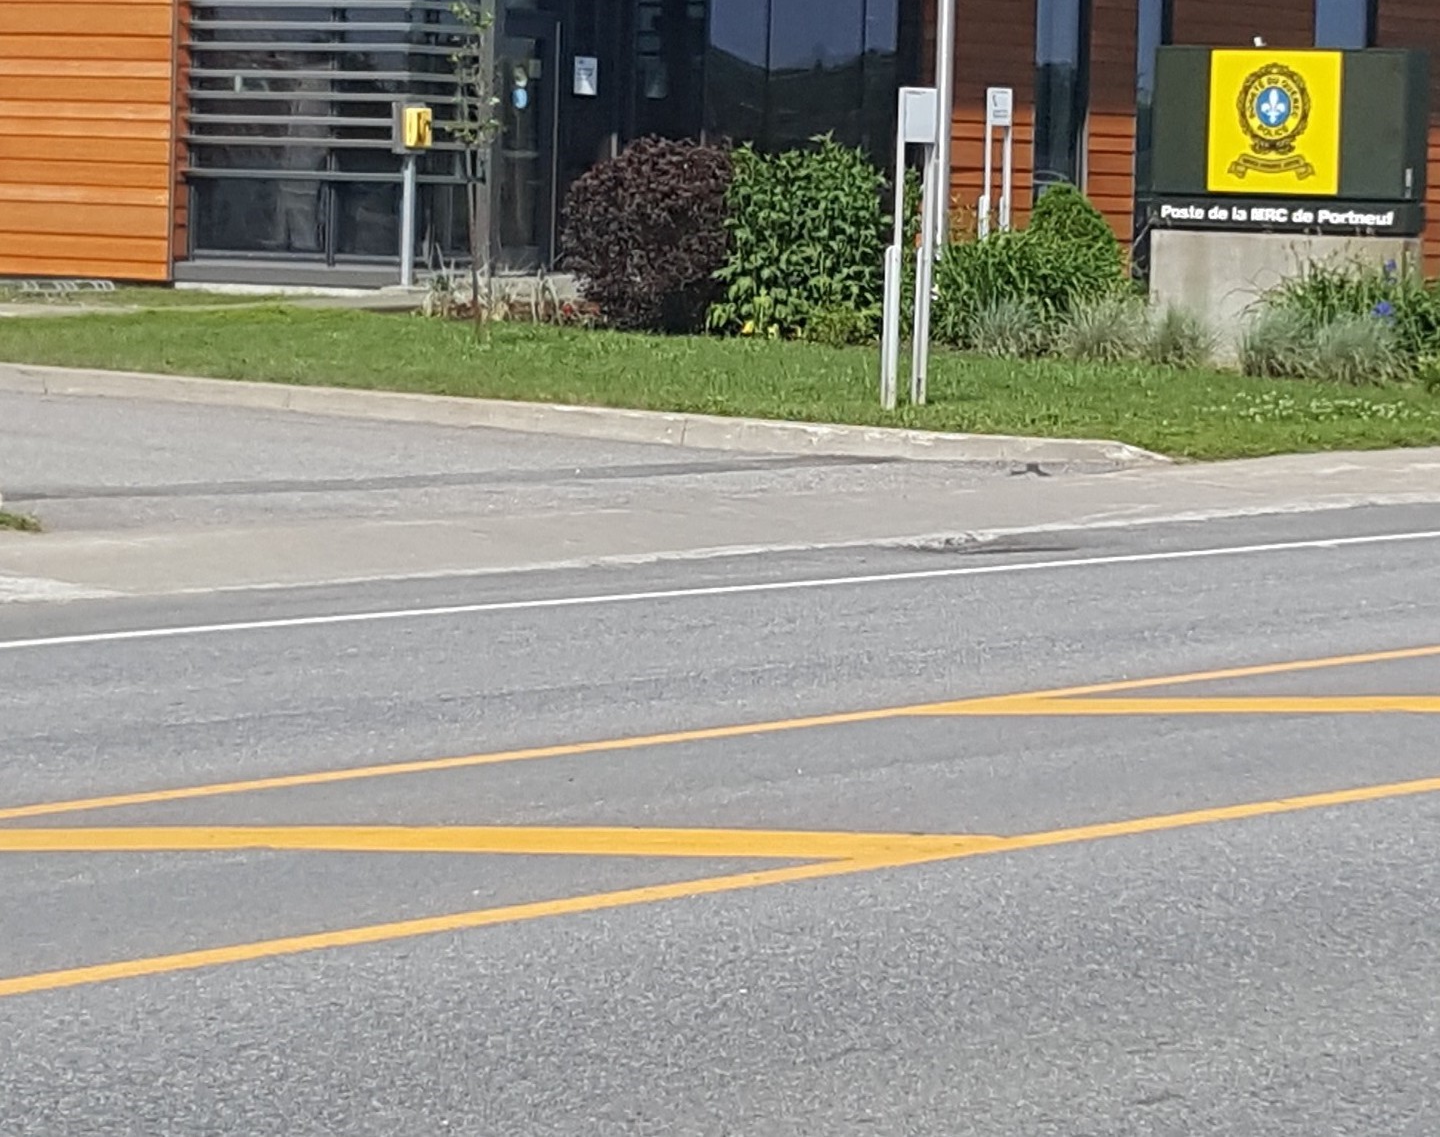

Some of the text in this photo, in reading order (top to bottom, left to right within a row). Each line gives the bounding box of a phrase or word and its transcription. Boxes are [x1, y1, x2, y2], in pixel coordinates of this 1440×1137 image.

[1160, 204, 1394, 226] Poste de la MRC de Portneuf
